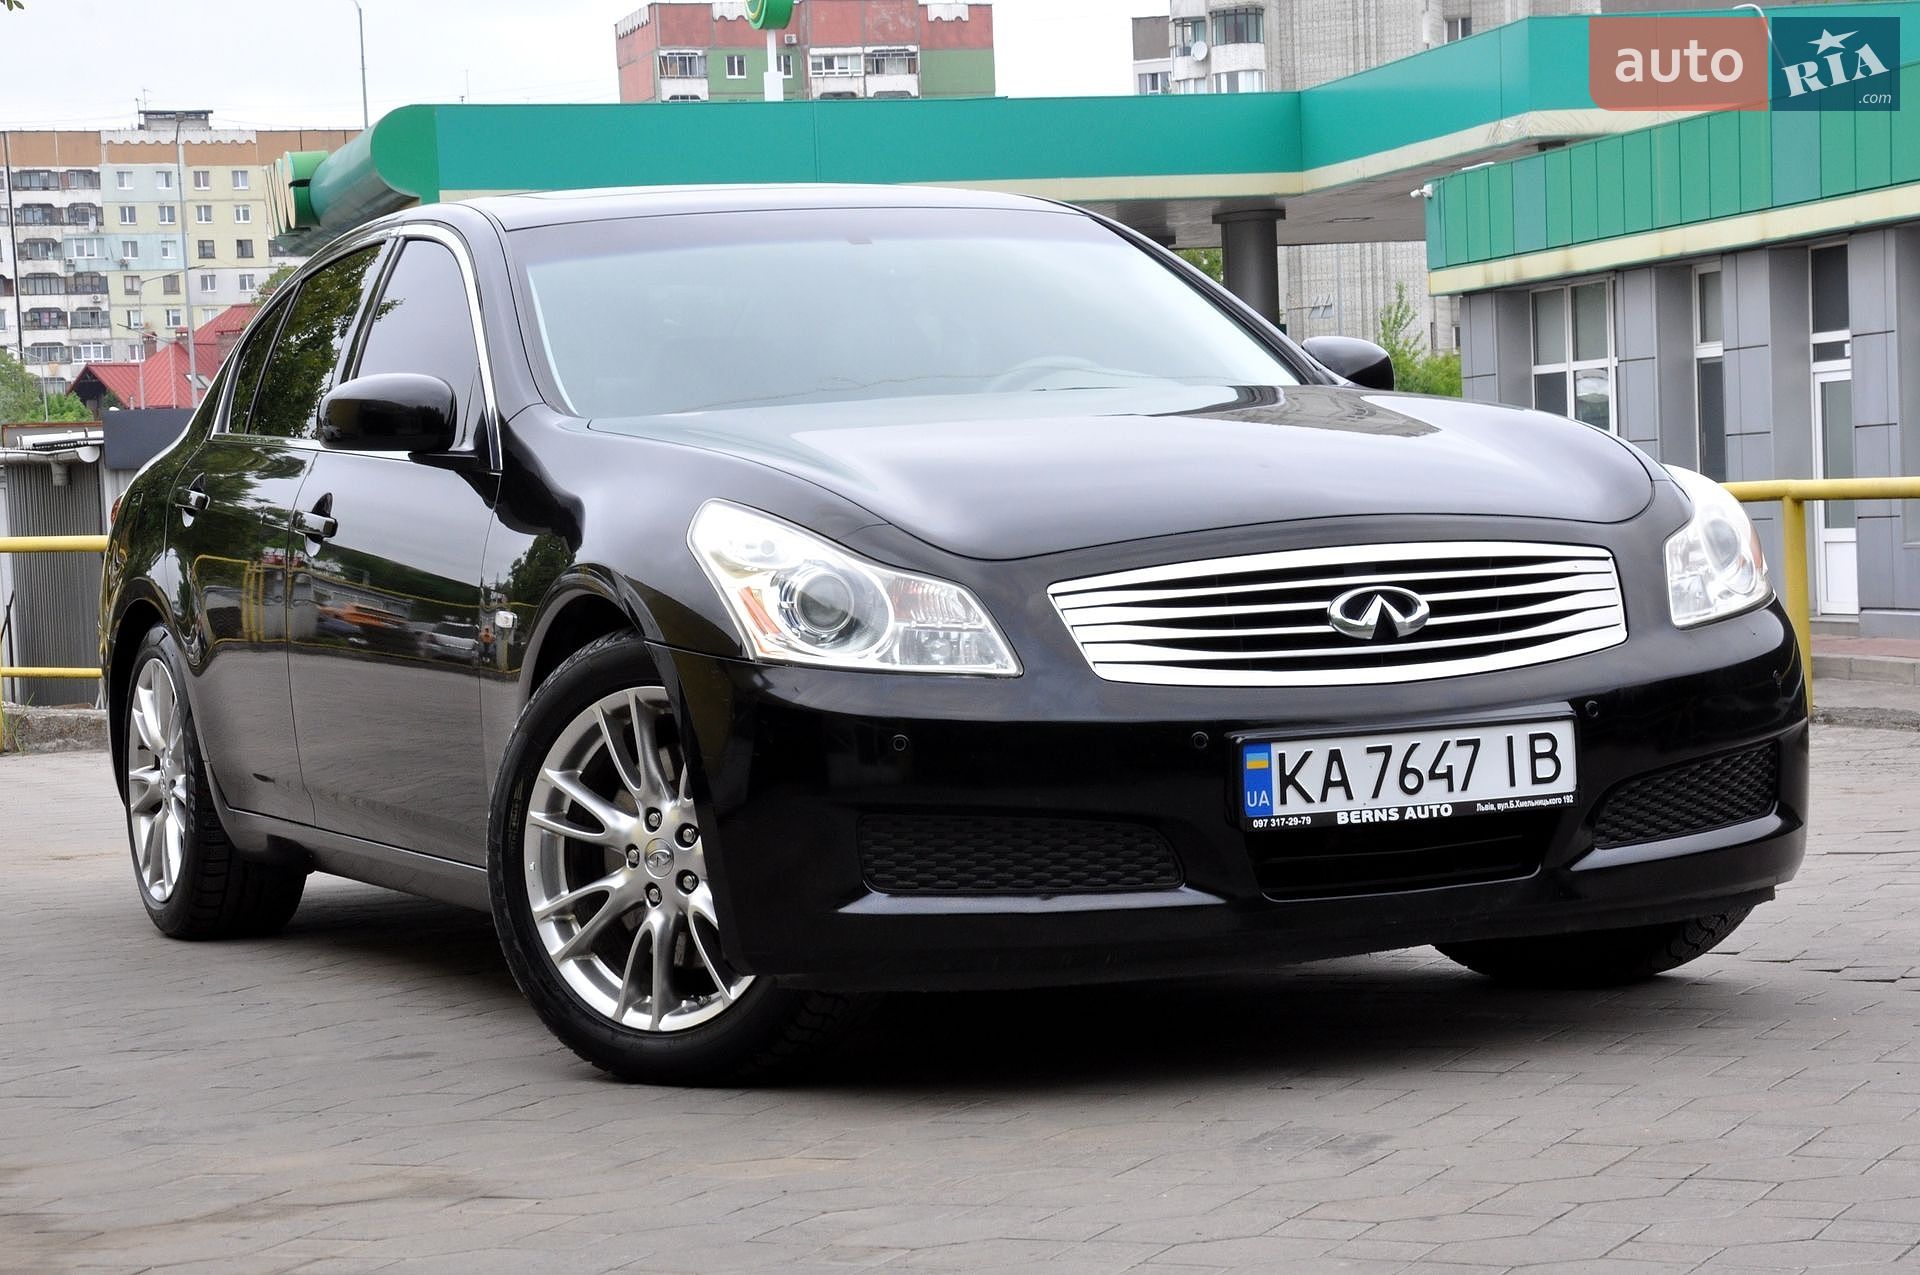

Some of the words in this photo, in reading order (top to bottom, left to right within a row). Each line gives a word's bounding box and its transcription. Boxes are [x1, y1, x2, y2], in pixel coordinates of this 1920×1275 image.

[1277, 748, 1354, 805] KA
[1365, 737, 1482, 799] 7647
[1506, 732, 1562, 787] IB
[1247, 790, 1270, 807] UA
[1253, 818, 1268, 829] 097
[1270, 816, 1312, 827] 317-29-79
[1336, 808, 1400, 825] BERNS
[1404, 803, 1453, 821] AUTO
